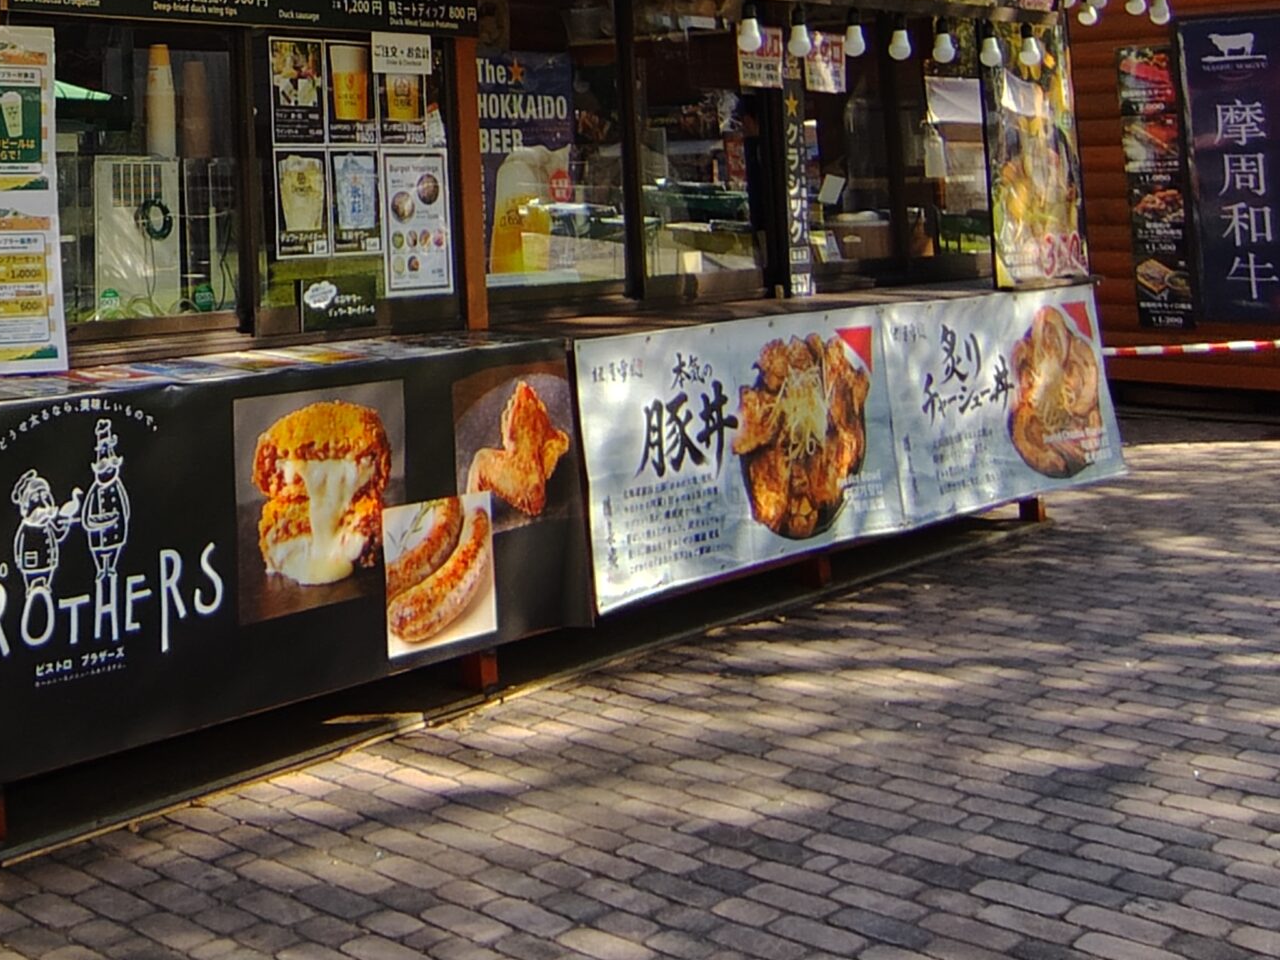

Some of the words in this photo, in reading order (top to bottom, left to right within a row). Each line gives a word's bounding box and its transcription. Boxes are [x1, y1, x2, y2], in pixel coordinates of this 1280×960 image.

[477, 93, 568, 121] HOKKAIDO
[478, 127, 524, 154] BEER
[1214, 99, 1280, 300] 摩周和牛
[634, 379, 739, 479] 豚丼
[35, 658, 73, 677] ビストロ
